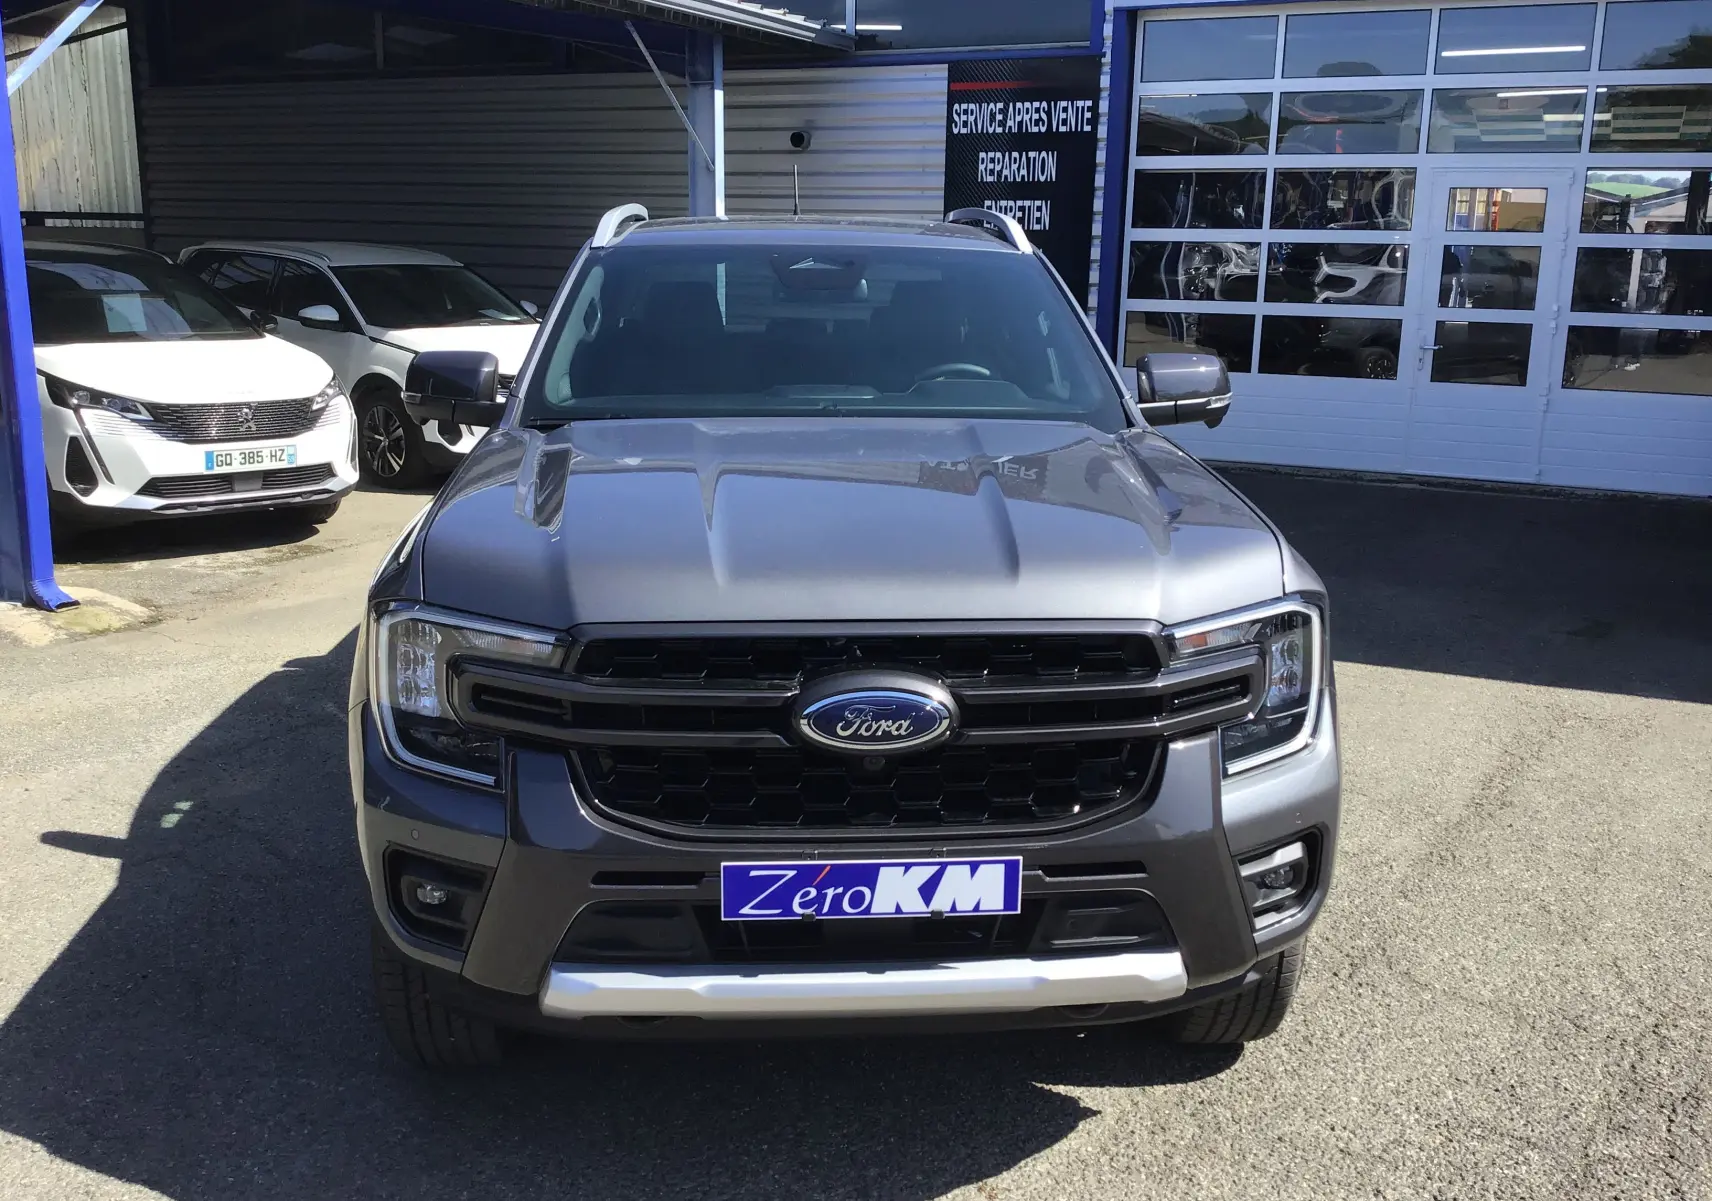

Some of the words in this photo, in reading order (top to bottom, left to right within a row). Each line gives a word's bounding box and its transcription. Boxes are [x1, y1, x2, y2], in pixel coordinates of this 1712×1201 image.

[952, 102, 1003, 135] SERVICE
[1005, 101, 1048, 133] APRES
[1051, 100, 1093, 132] VENTE
[978, 151, 1057, 182] REPARATION
[836, 704, 914, 737] Ford
